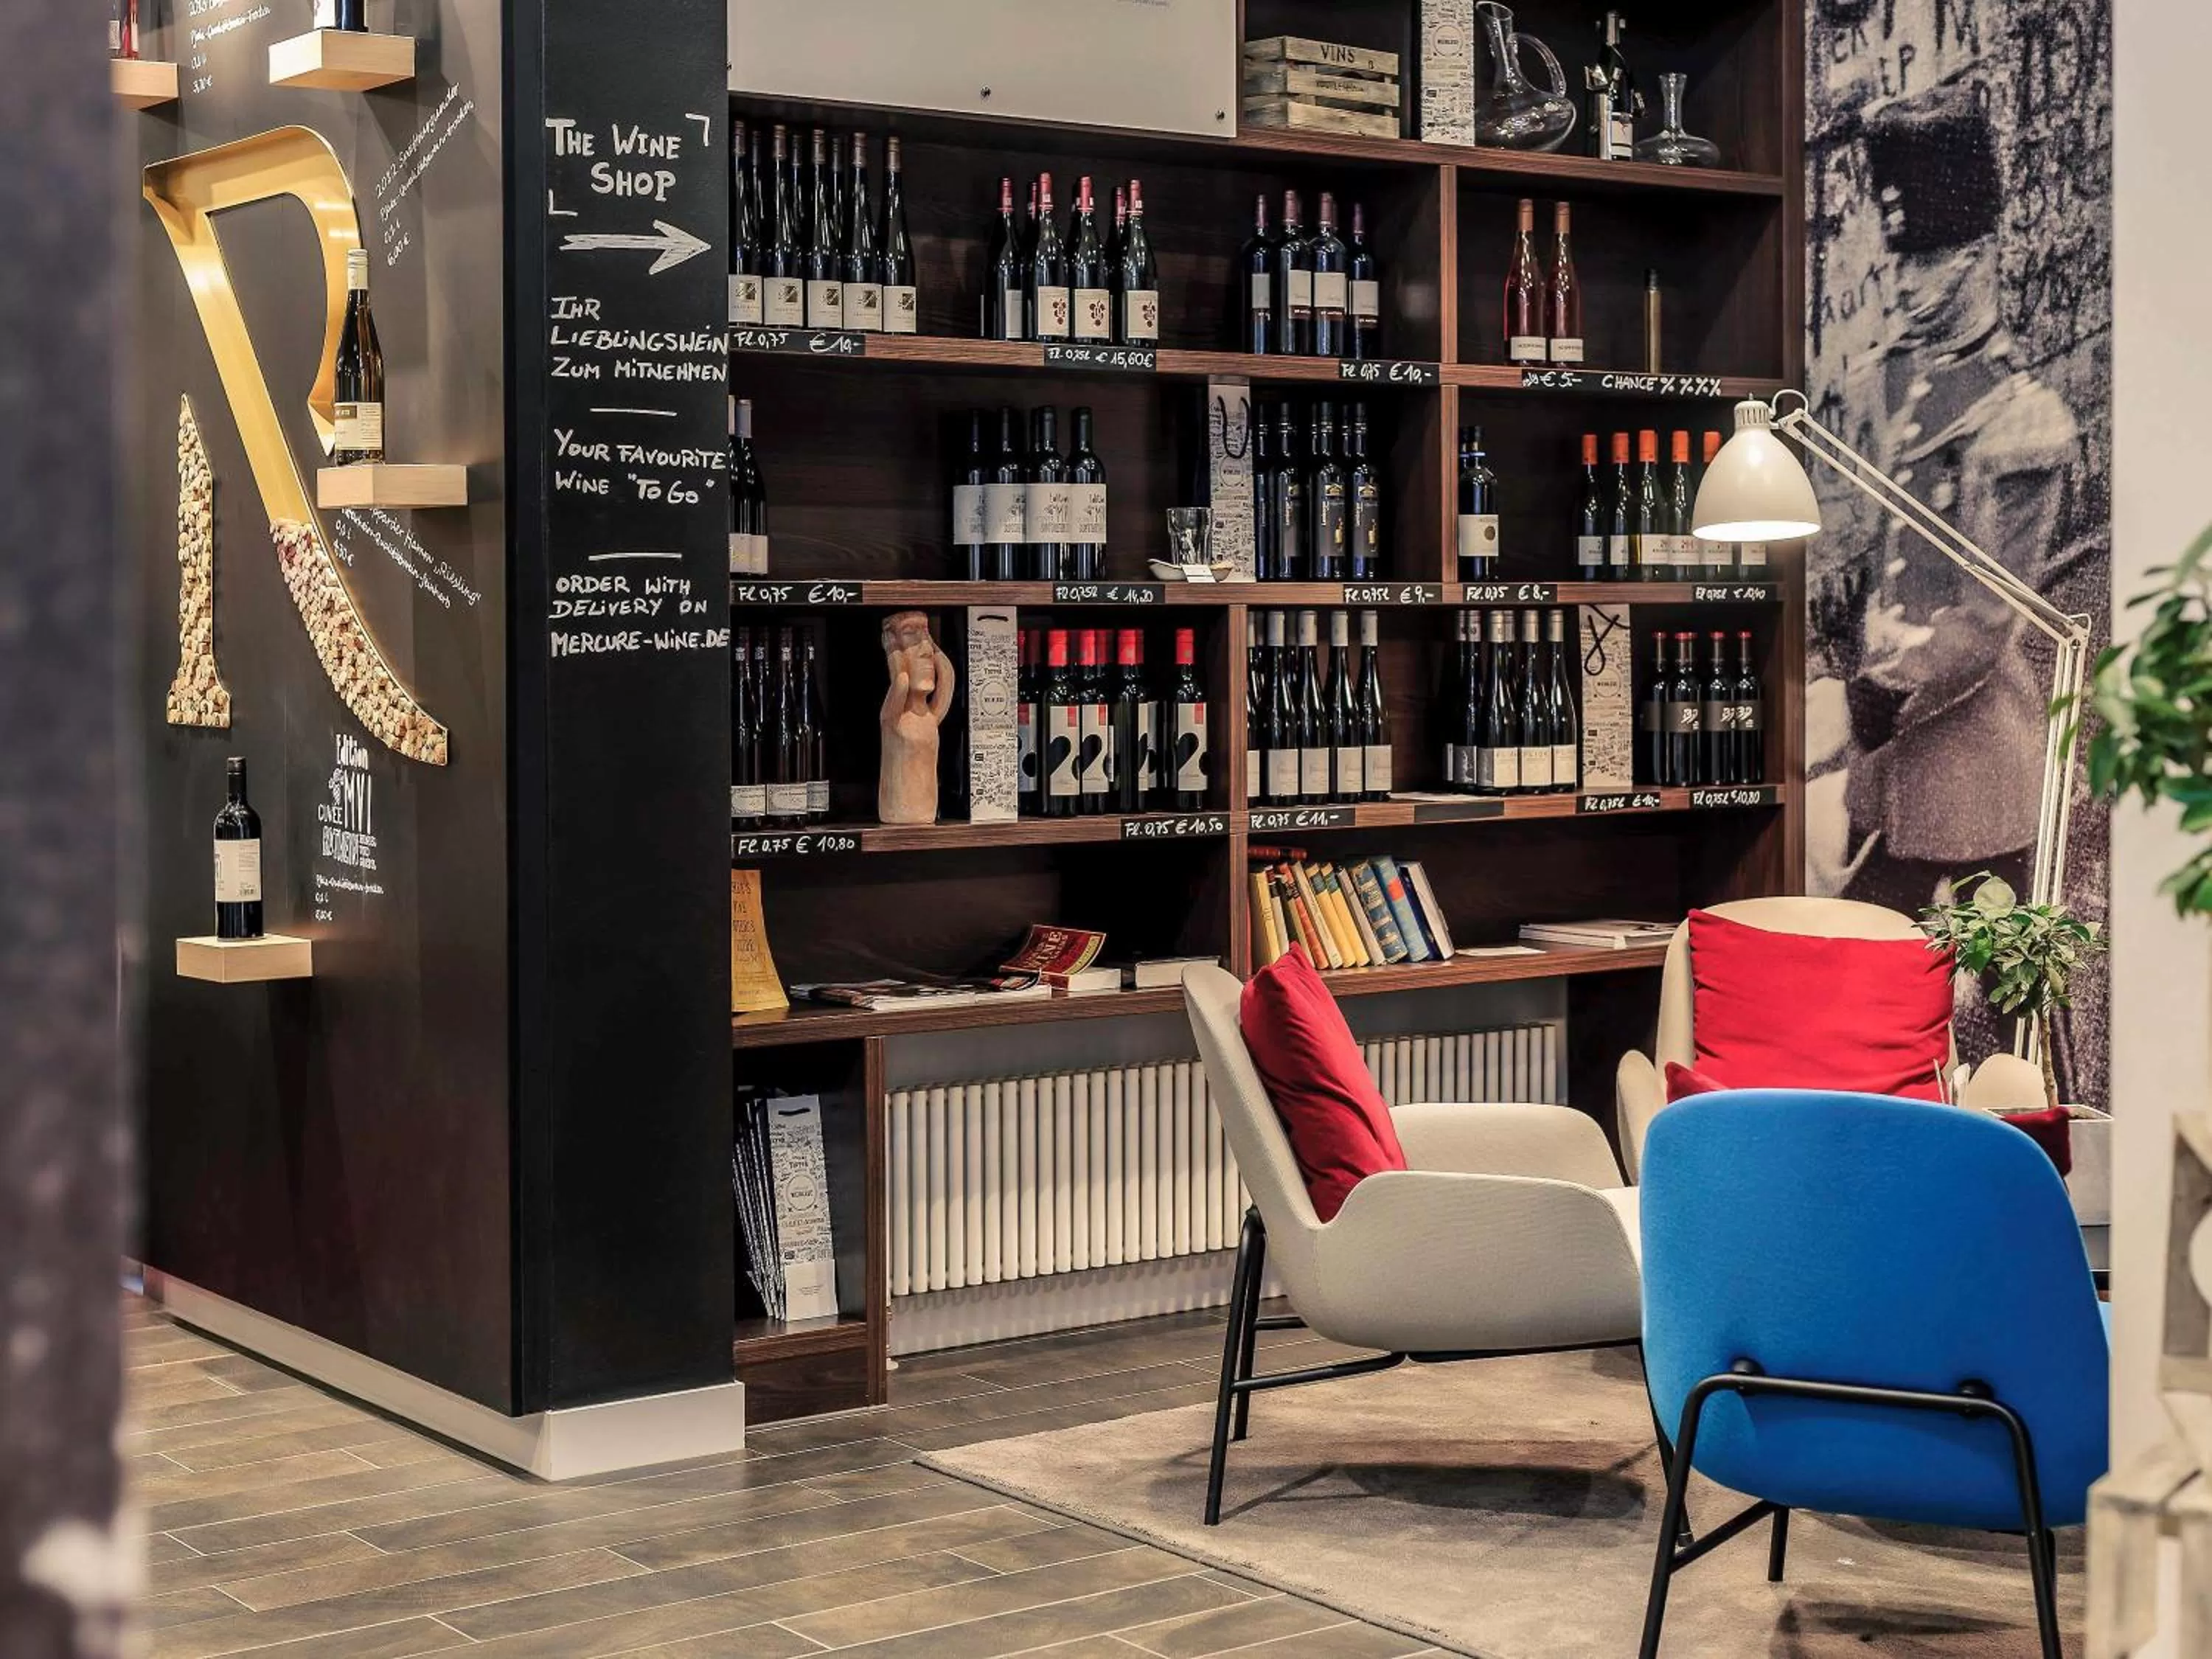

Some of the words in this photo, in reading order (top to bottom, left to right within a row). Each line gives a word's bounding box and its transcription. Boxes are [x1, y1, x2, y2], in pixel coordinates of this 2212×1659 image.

[1321, 44, 1357, 63] VINS
[545, 118, 595, 156] THE
[612, 124, 682, 160] WINE
[591, 161, 676, 202] SHOP
[551, 296, 601, 321] IHR
[551, 357, 601, 380] ZUM
[1601, 373, 1659, 392] CHANCE
[554, 428, 611, 462] YOUR
[616, 445, 726, 470] FAVOURITE
[554, 470, 611, 495] WINE
[556, 574, 630, 594] ORDER
[645, 577, 692, 596] WITH
[549, 599, 663, 619] DELIVERY
[679, 599, 708, 616] ON
